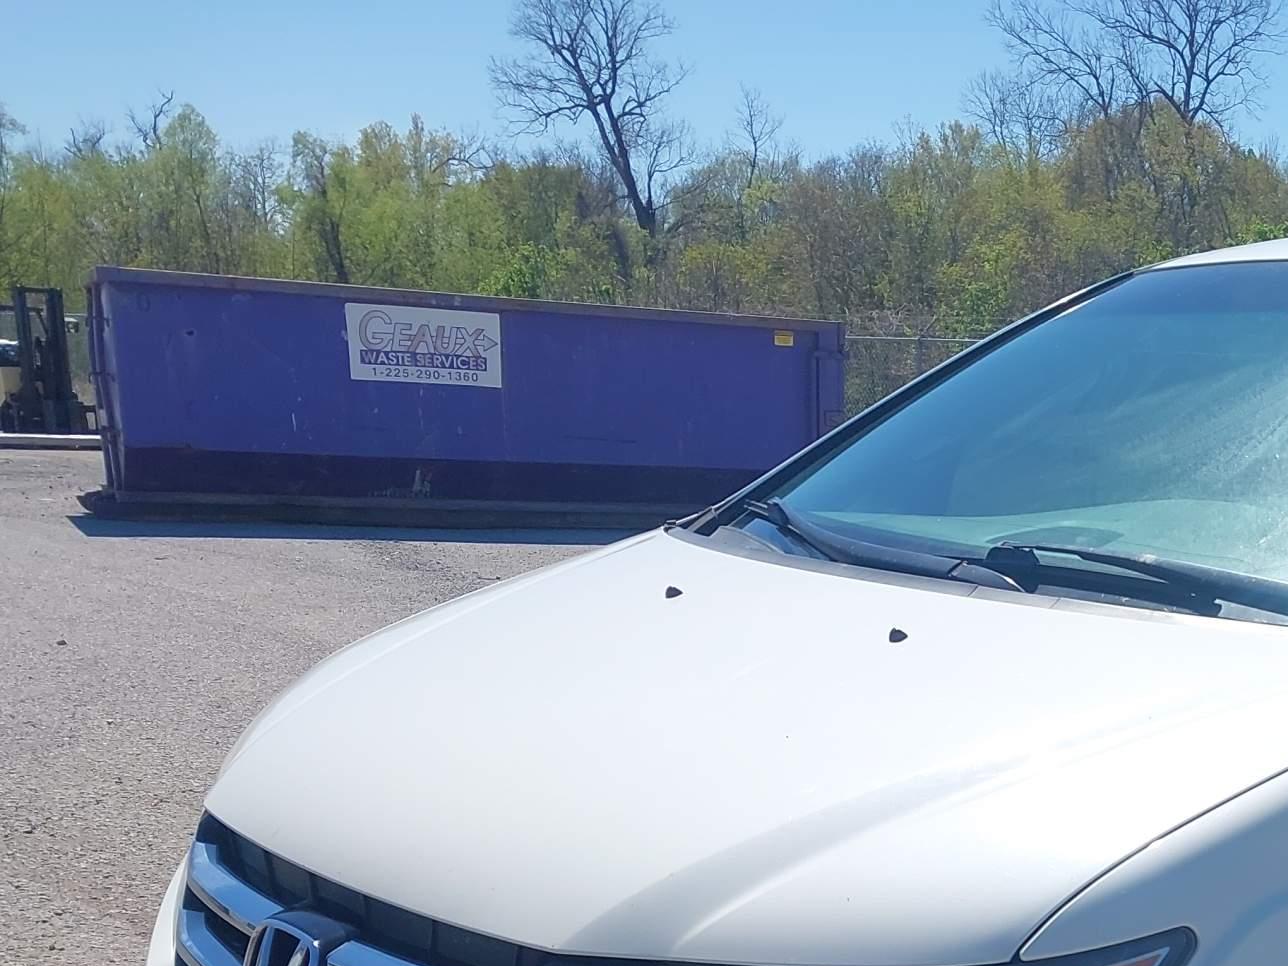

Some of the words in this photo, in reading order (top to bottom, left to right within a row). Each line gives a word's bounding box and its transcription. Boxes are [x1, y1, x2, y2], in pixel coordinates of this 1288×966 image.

[359, 309, 484, 357] GEAUX
[361, 350, 412, 366] WASTE
[416, 353, 486, 371] SERVICES
[372, 367, 479, 383] 1-225-290-1360
